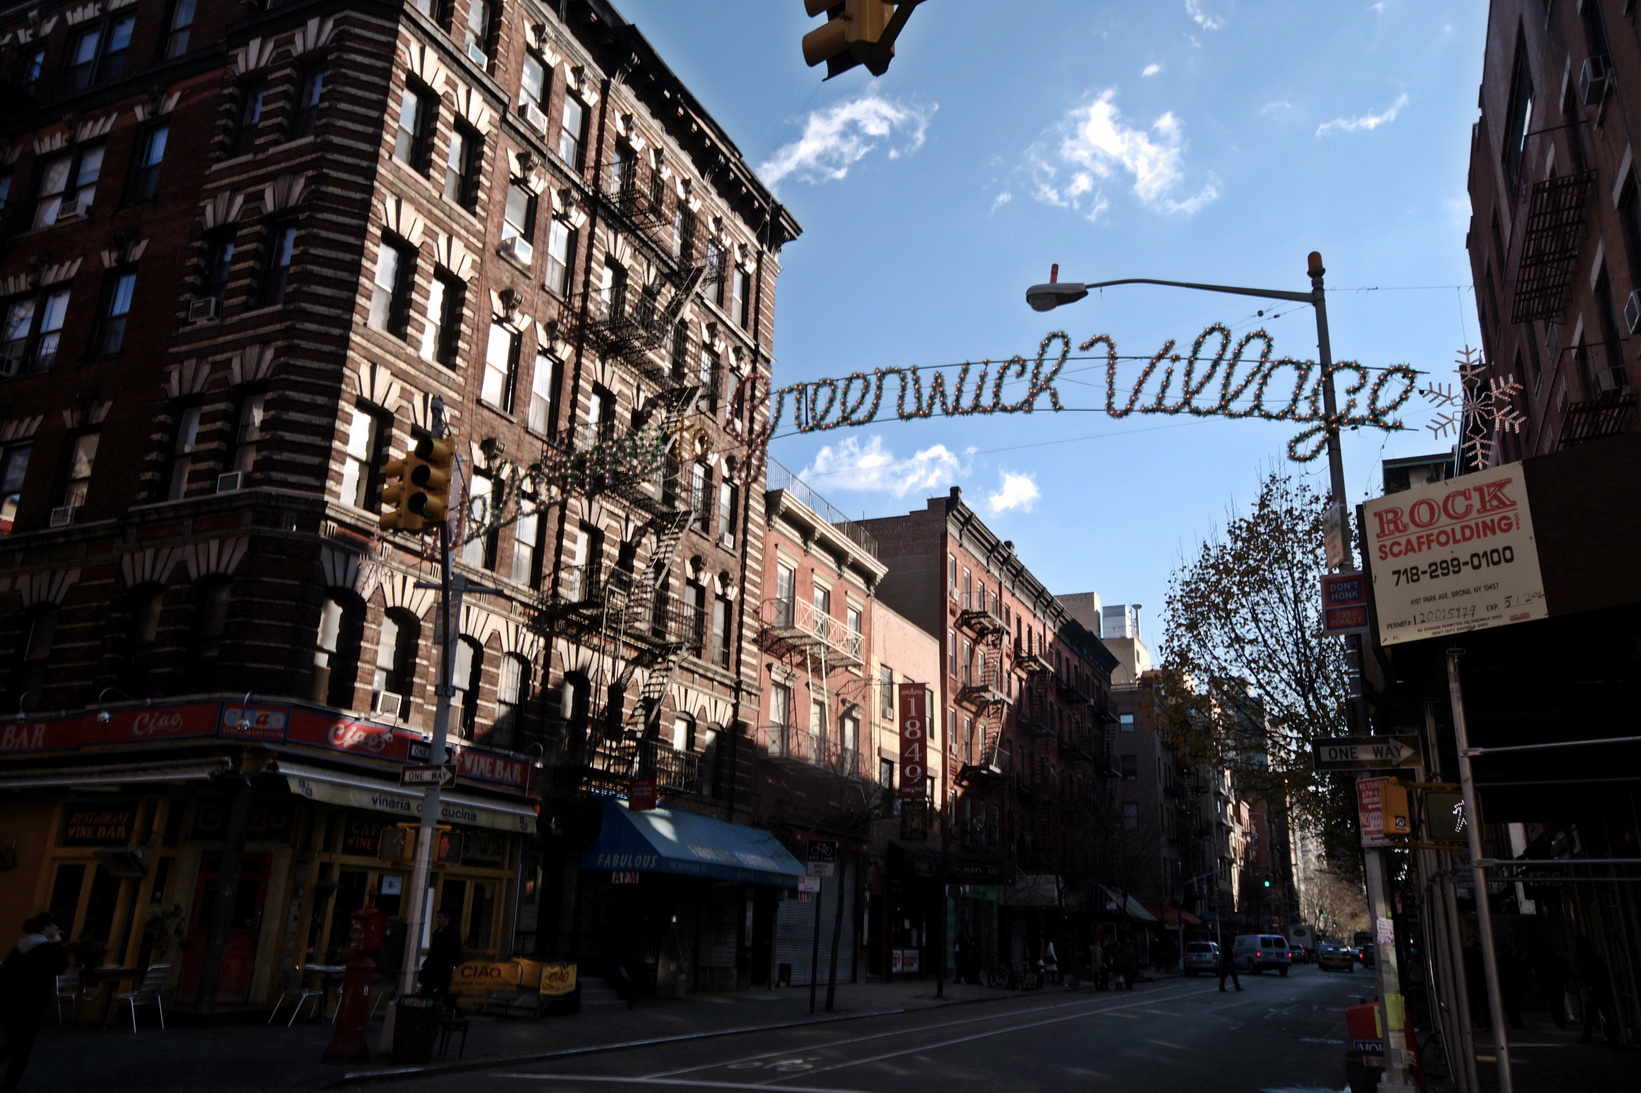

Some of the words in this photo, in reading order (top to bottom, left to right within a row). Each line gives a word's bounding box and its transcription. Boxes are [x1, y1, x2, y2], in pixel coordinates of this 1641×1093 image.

[1078, 321, 1418, 463] Village
[1373, 477, 1517, 539] ROCK
[1378, 515, 1514, 561] SCAFFOLDING
[1391, 545, 1515, 587] 718-299-0100
[1330, 580, 1359, 592] DON'T
[1423, 594, 1437, 604] PARK
[1473, 586, 1482, 594] NY
[1483, 582, 1499, 592] 10457
[1331, 590, 1359, 601] HONK
[1331, 616, 1362, 626] PENALTY
[132, 712, 184, 737] Ciao
[1, 724, 46, 749] BAR
[328, 723, 388, 752] Ciao
[903, 697, 922, 785] 1849
[414, 747, 427, 757] ONE
[1328, 747, 1359, 760] ONE
[1372, 745, 1403, 759] WAY
[464, 753, 493, 778] WINE
[494, 760, 522, 784] BAR
[408, 771, 424, 782] ONE
[431, 771, 447, 781] WAY
[372, 796, 411, 811] vineria
[441, 807, 477, 821] cucina
[70, 810, 131, 825] RESTAURANT
[67, 825, 95, 839] WINE
[97, 824, 127, 839] BAR
[347, 835, 375, 850] WINE
[597, 853, 658, 869] FABULOUS
[613, 871, 640, 884] ATM
[460, 965, 502, 979] CIAO
[548, 970, 570, 984] CIAO
